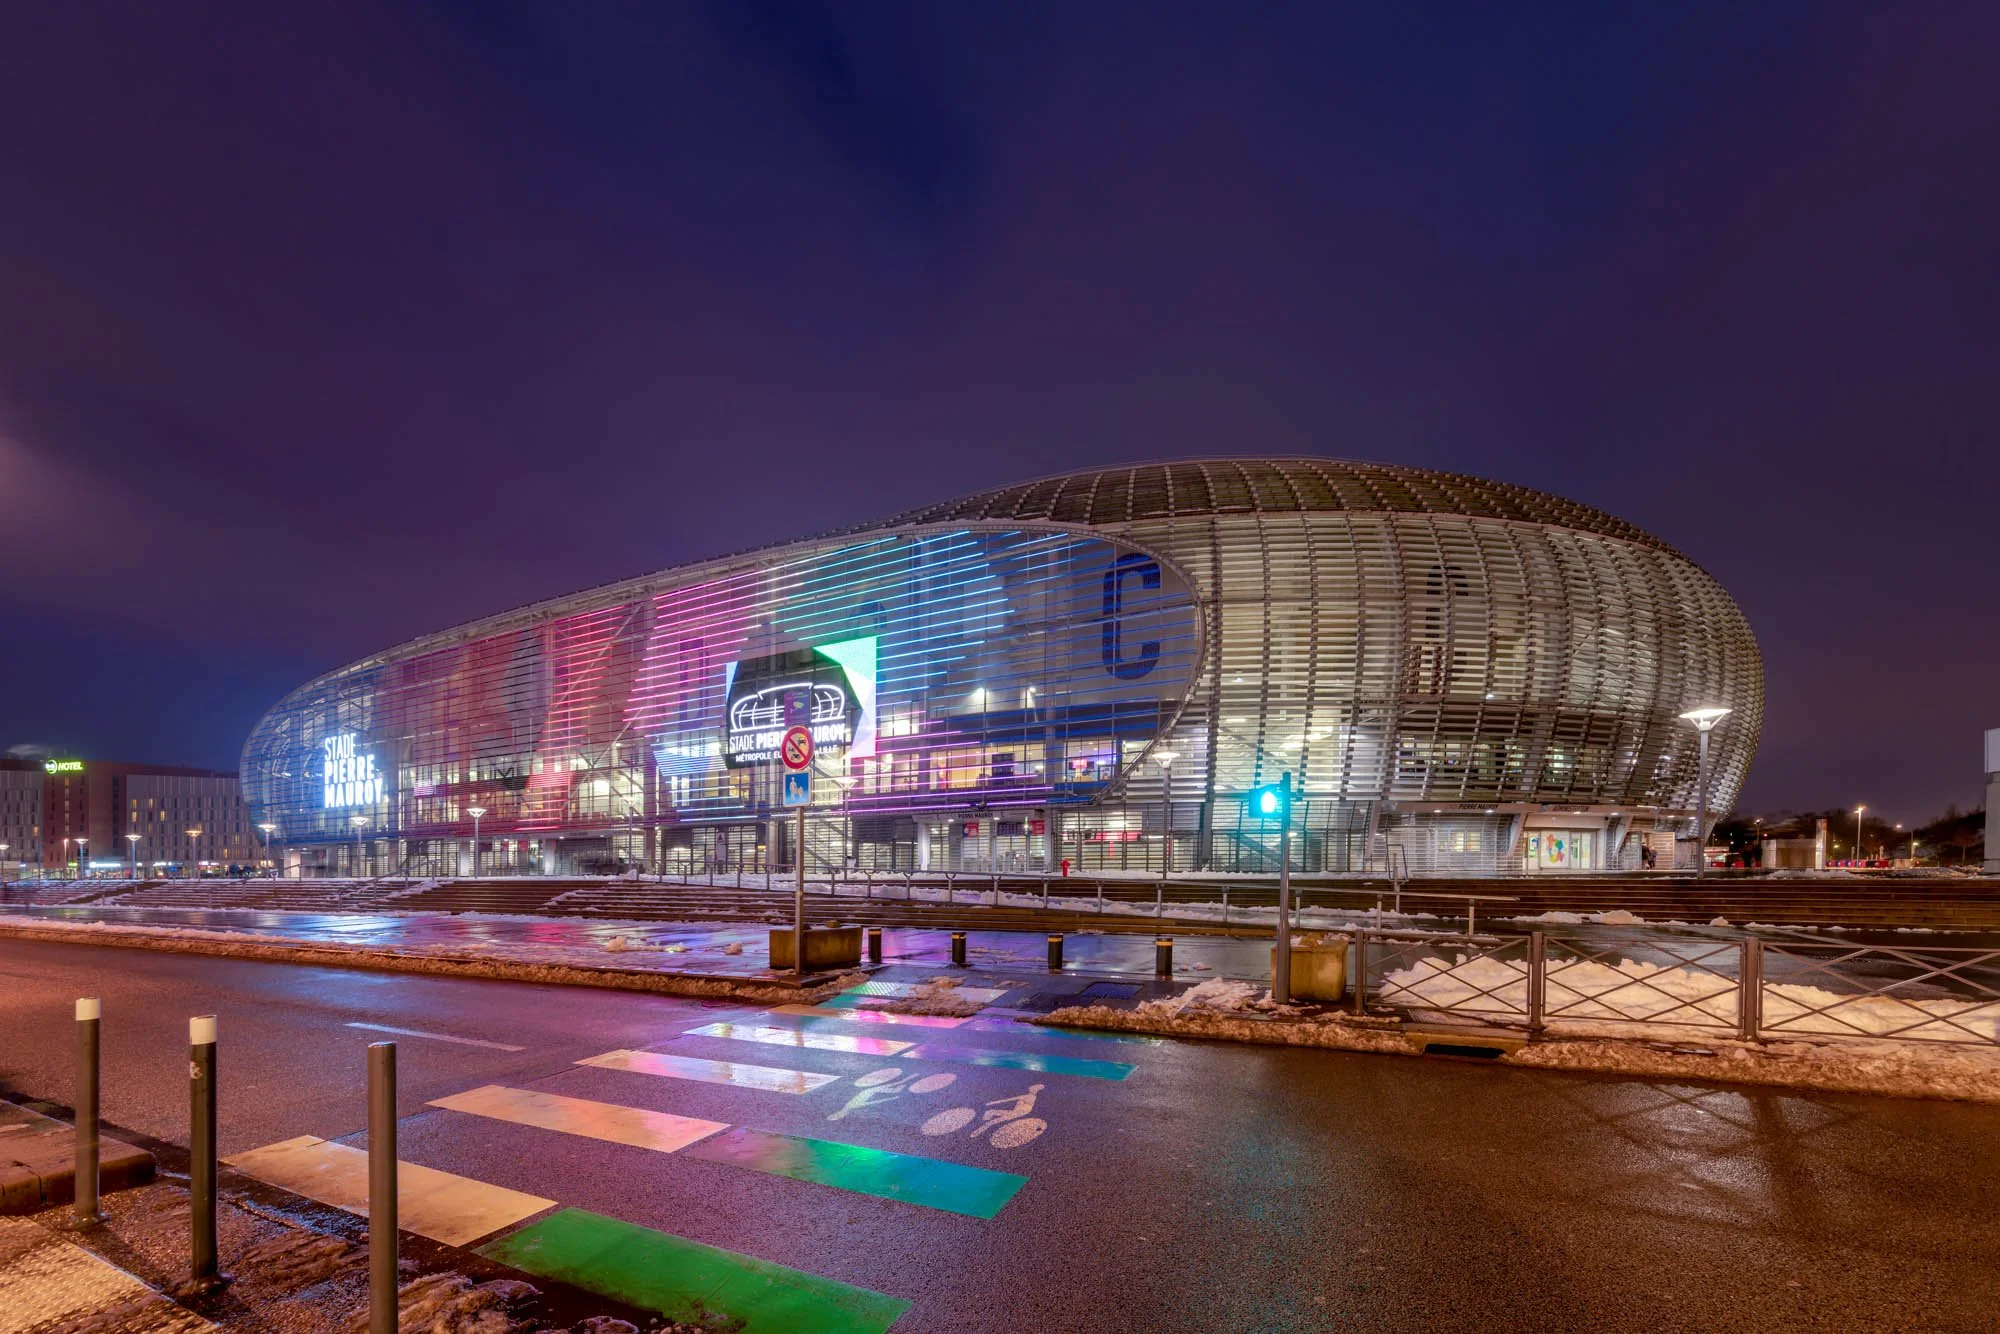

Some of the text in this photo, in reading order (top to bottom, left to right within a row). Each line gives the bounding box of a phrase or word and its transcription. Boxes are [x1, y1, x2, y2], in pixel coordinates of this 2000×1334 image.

[1102, 552, 1160, 680] C
[324, 733, 356, 761] STADE
[730, 723, 845, 754] STADE PIER UROY
[324, 754, 375, 785] PIERRE
[736, 751, 771, 762] MÉTROPOLE
[324, 778, 383, 809] MAUROY
